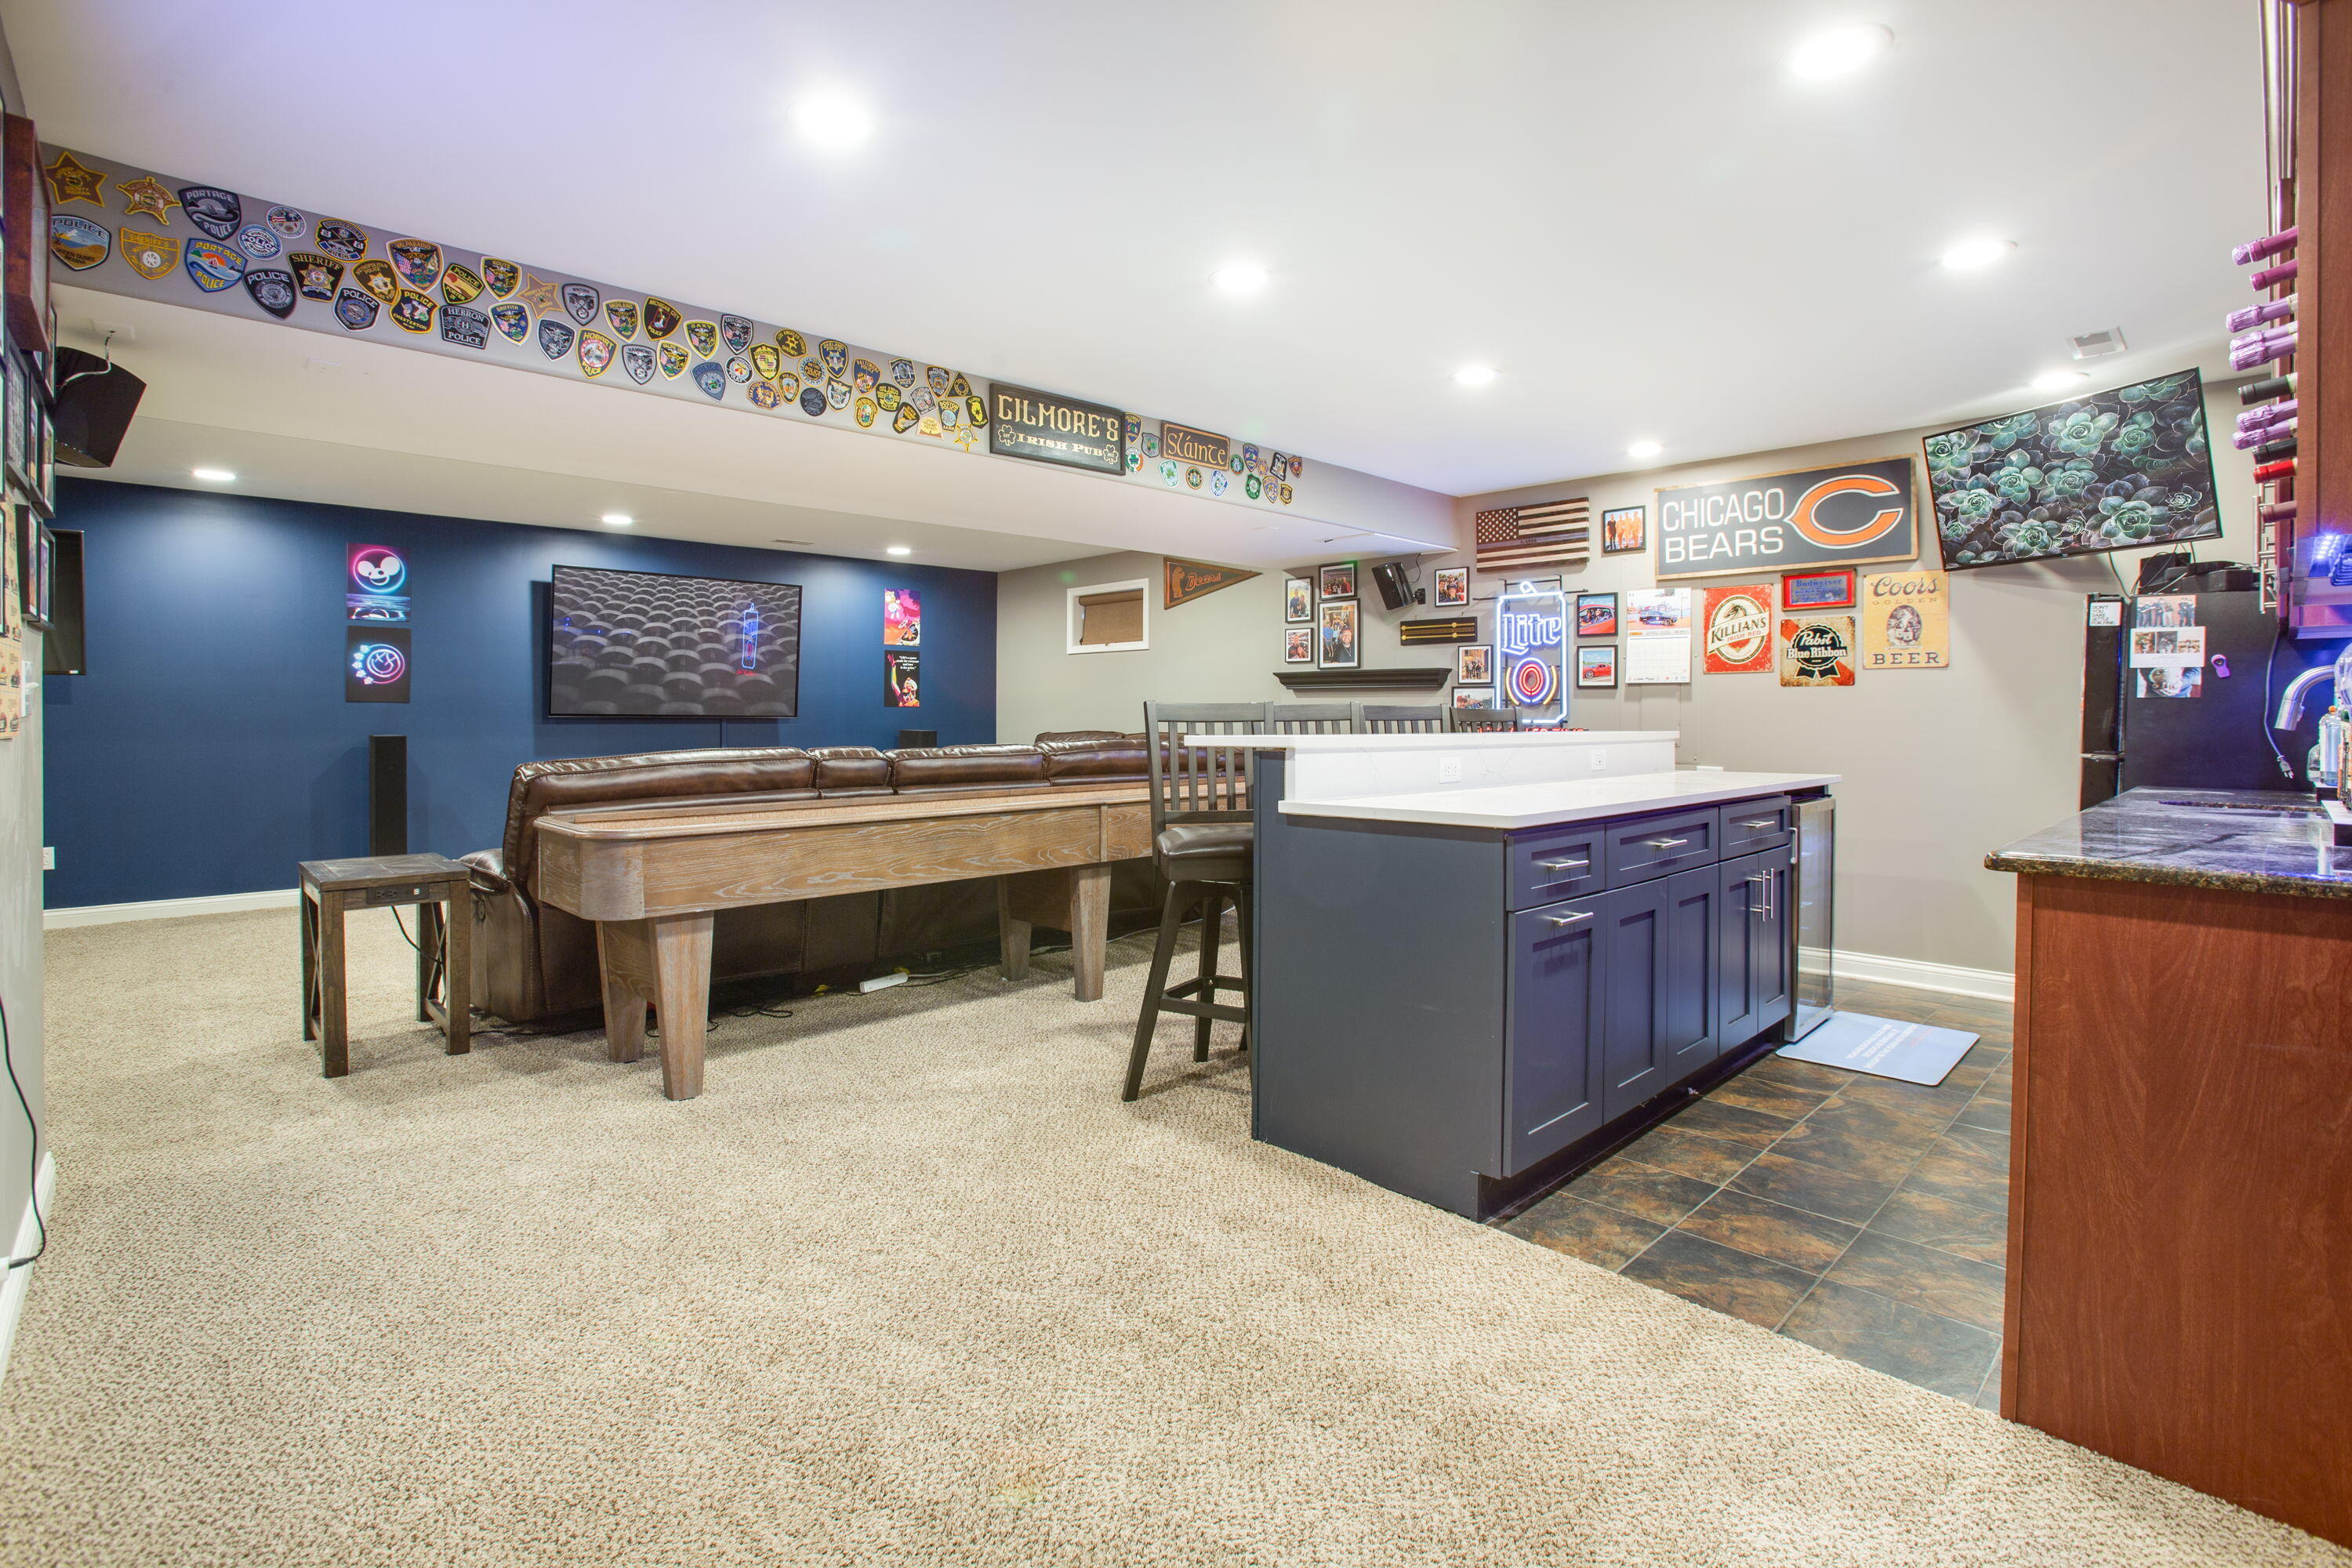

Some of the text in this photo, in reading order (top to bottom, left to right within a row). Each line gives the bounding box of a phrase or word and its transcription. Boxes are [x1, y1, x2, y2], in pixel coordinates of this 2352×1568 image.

[186, 190, 234, 202] PORTAGE
[52, 219, 107, 241] POLICE
[204, 222, 233, 238] POLICE
[129, 234, 170, 249] SHERIFF'S
[241, 234, 279, 254] POLICE
[395, 241, 431, 250] VALPARAISO
[195, 241, 244, 266] PORTAGE
[292, 255, 342, 270] SHERIFF
[196, 270, 225, 289] POLICE
[248, 271, 290, 285] POLICE
[454, 267, 480, 288] POLICE
[343, 289, 378, 308] POLICE
[404, 291, 434, 308] POLICE
[393, 313, 427, 330] CHESTERTON
[448, 307, 485, 321] HEBRON
[448, 331, 481, 345] POLICE
[583, 332, 614, 350] HOBART
[582, 361, 601, 376] POLICE
[997, 394, 1119, 441] GILMORE'S
[1016, 433, 1069, 451] IRISH
[1167, 432, 1226, 466] Sláinte
[1662, 487, 1784, 532] CHICAGO
[1664, 525, 1784, 564] BEARS
[1185, 572, 1221, 591] Bears
[1795, 579, 1842, 587] Budweiser
[1870, 575, 1940, 597] Coors
[1872, 597, 1938, 606] GOLDEN
[1501, 613, 1562, 655] Lite
[1799, 630, 1835, 646] Pabst
[1786, 646, 1848, 659] Blue Ribbon
[1872, 652, 1940, 665] BEER
